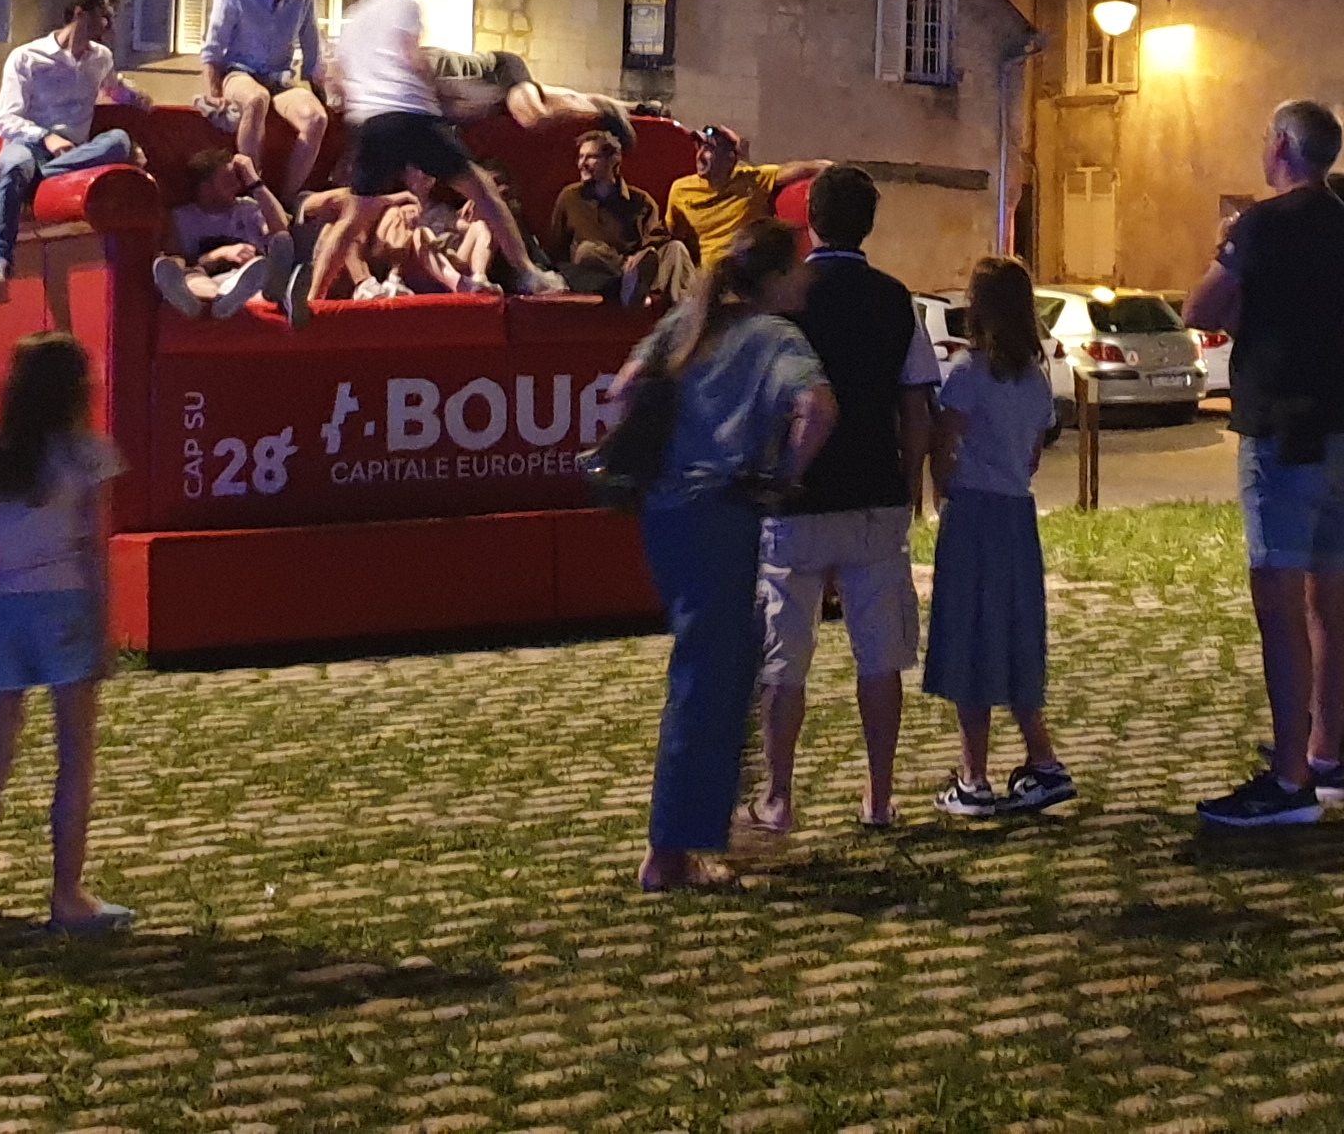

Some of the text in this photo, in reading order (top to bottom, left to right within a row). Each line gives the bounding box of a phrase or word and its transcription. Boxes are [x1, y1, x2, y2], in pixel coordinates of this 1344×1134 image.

[184, 438, 204, 498] CAP
[211, 427, 296, 496] 28
[331, 458, 449, 484] CAPITALE
